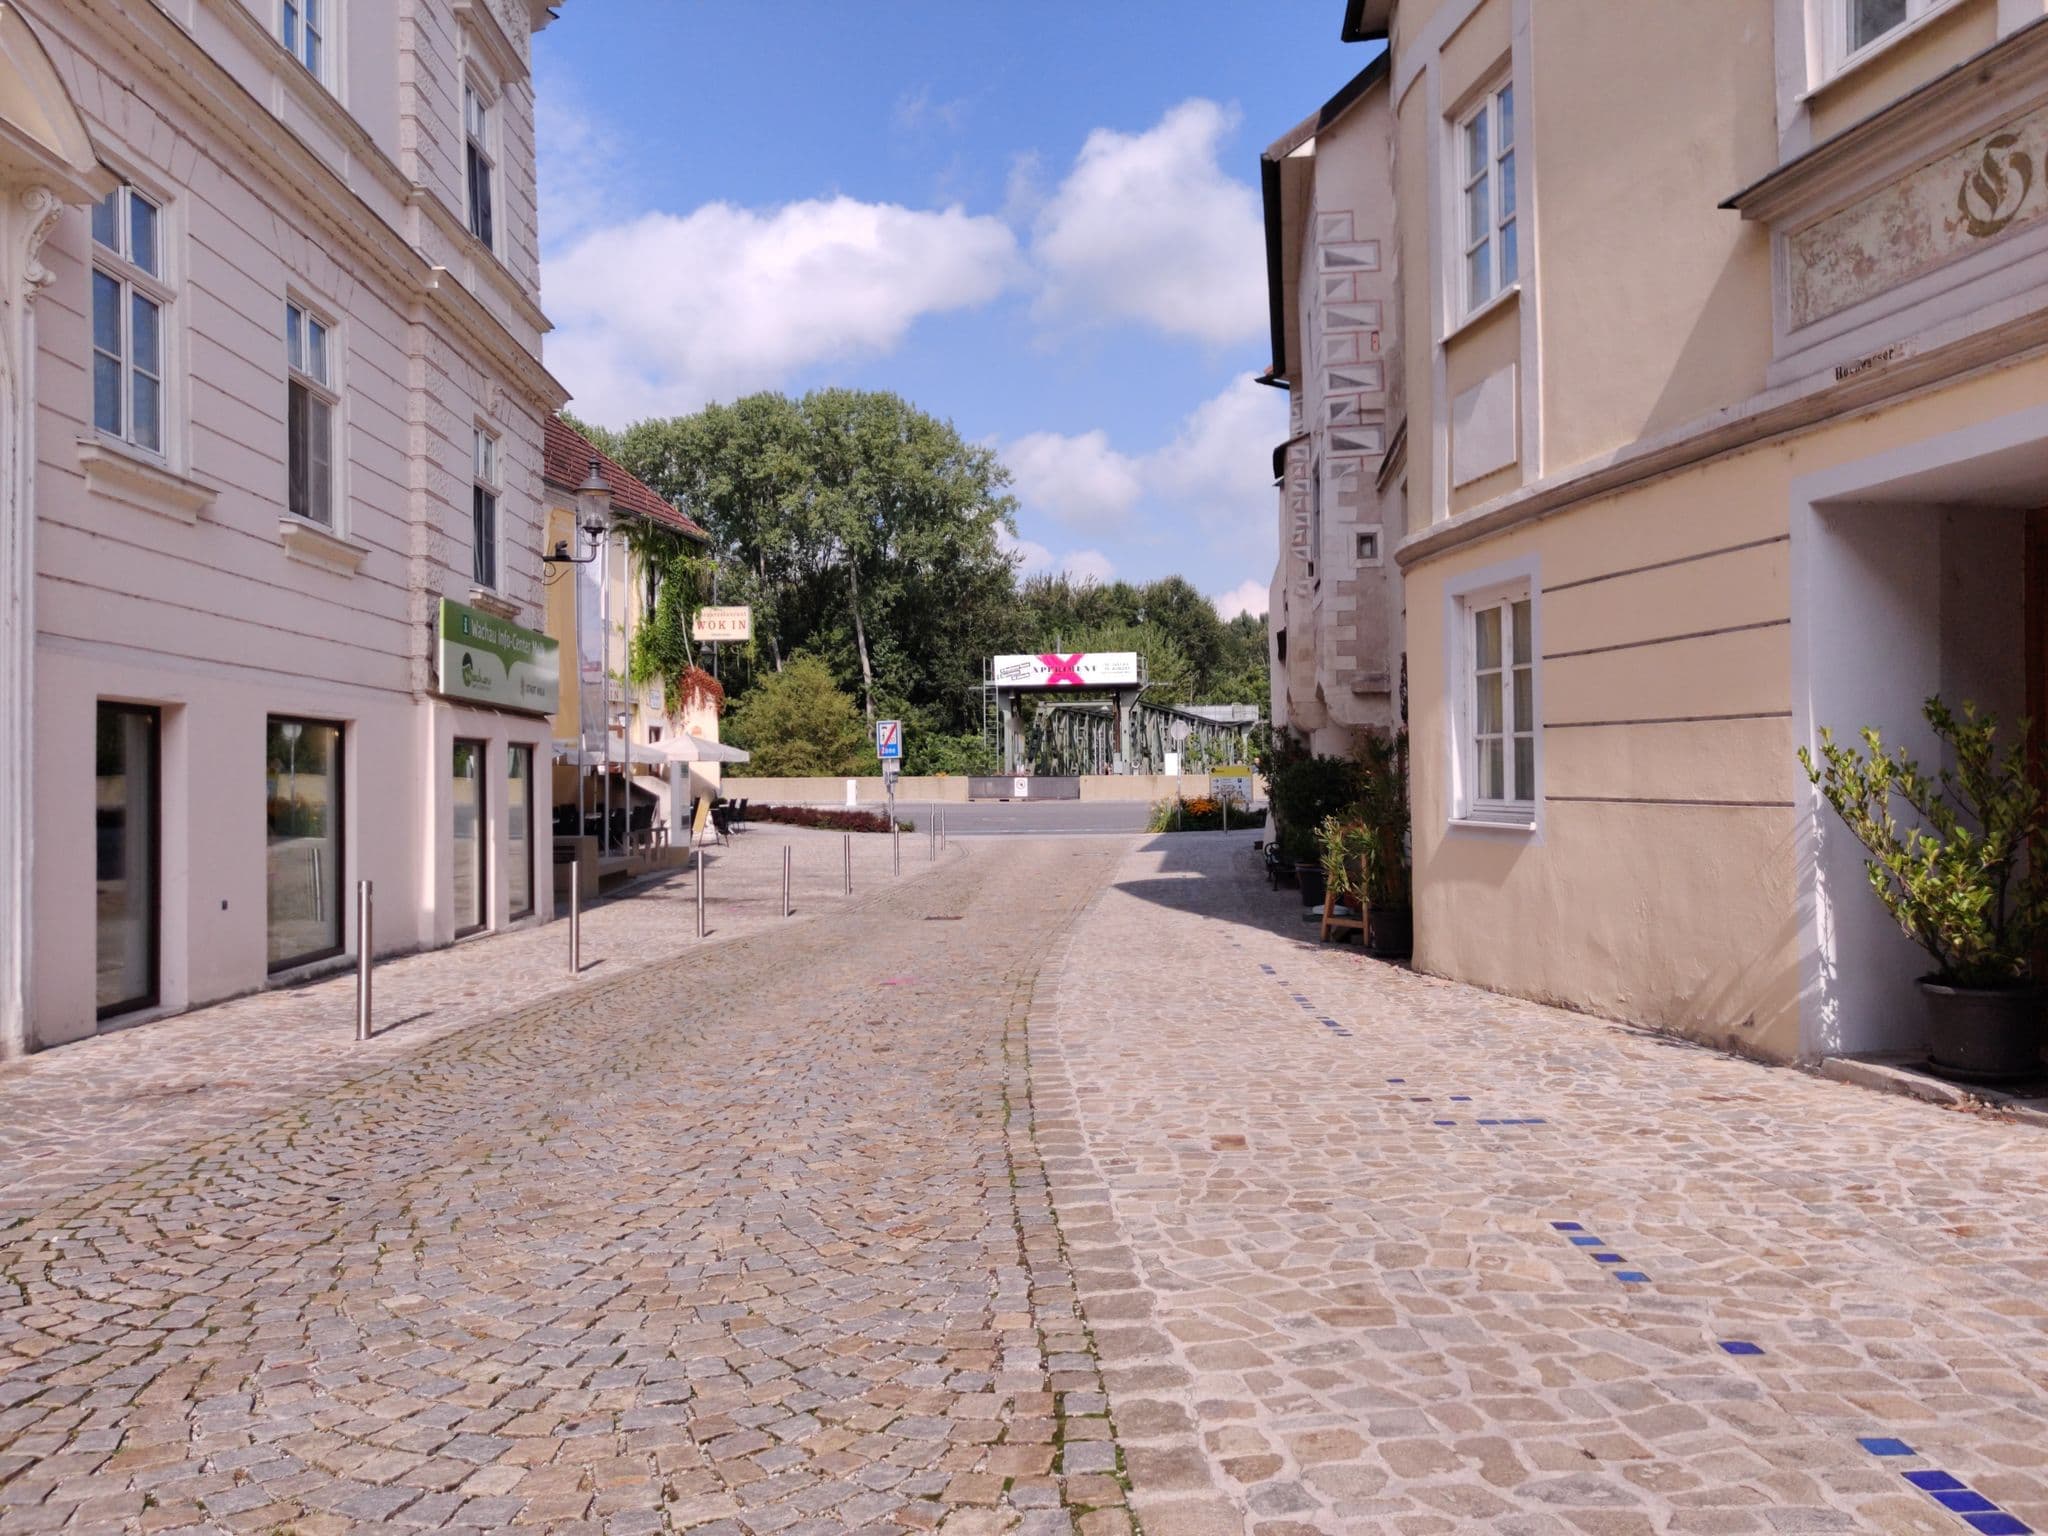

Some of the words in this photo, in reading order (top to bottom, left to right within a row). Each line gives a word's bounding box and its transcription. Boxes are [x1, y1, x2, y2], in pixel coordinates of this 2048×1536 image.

[471, 619, 497, 644] Wachau
[498, 629, 531, 653] Info-Center
[696, 620, 726, 630] WOK
[732, 620, 746, 630] IN
